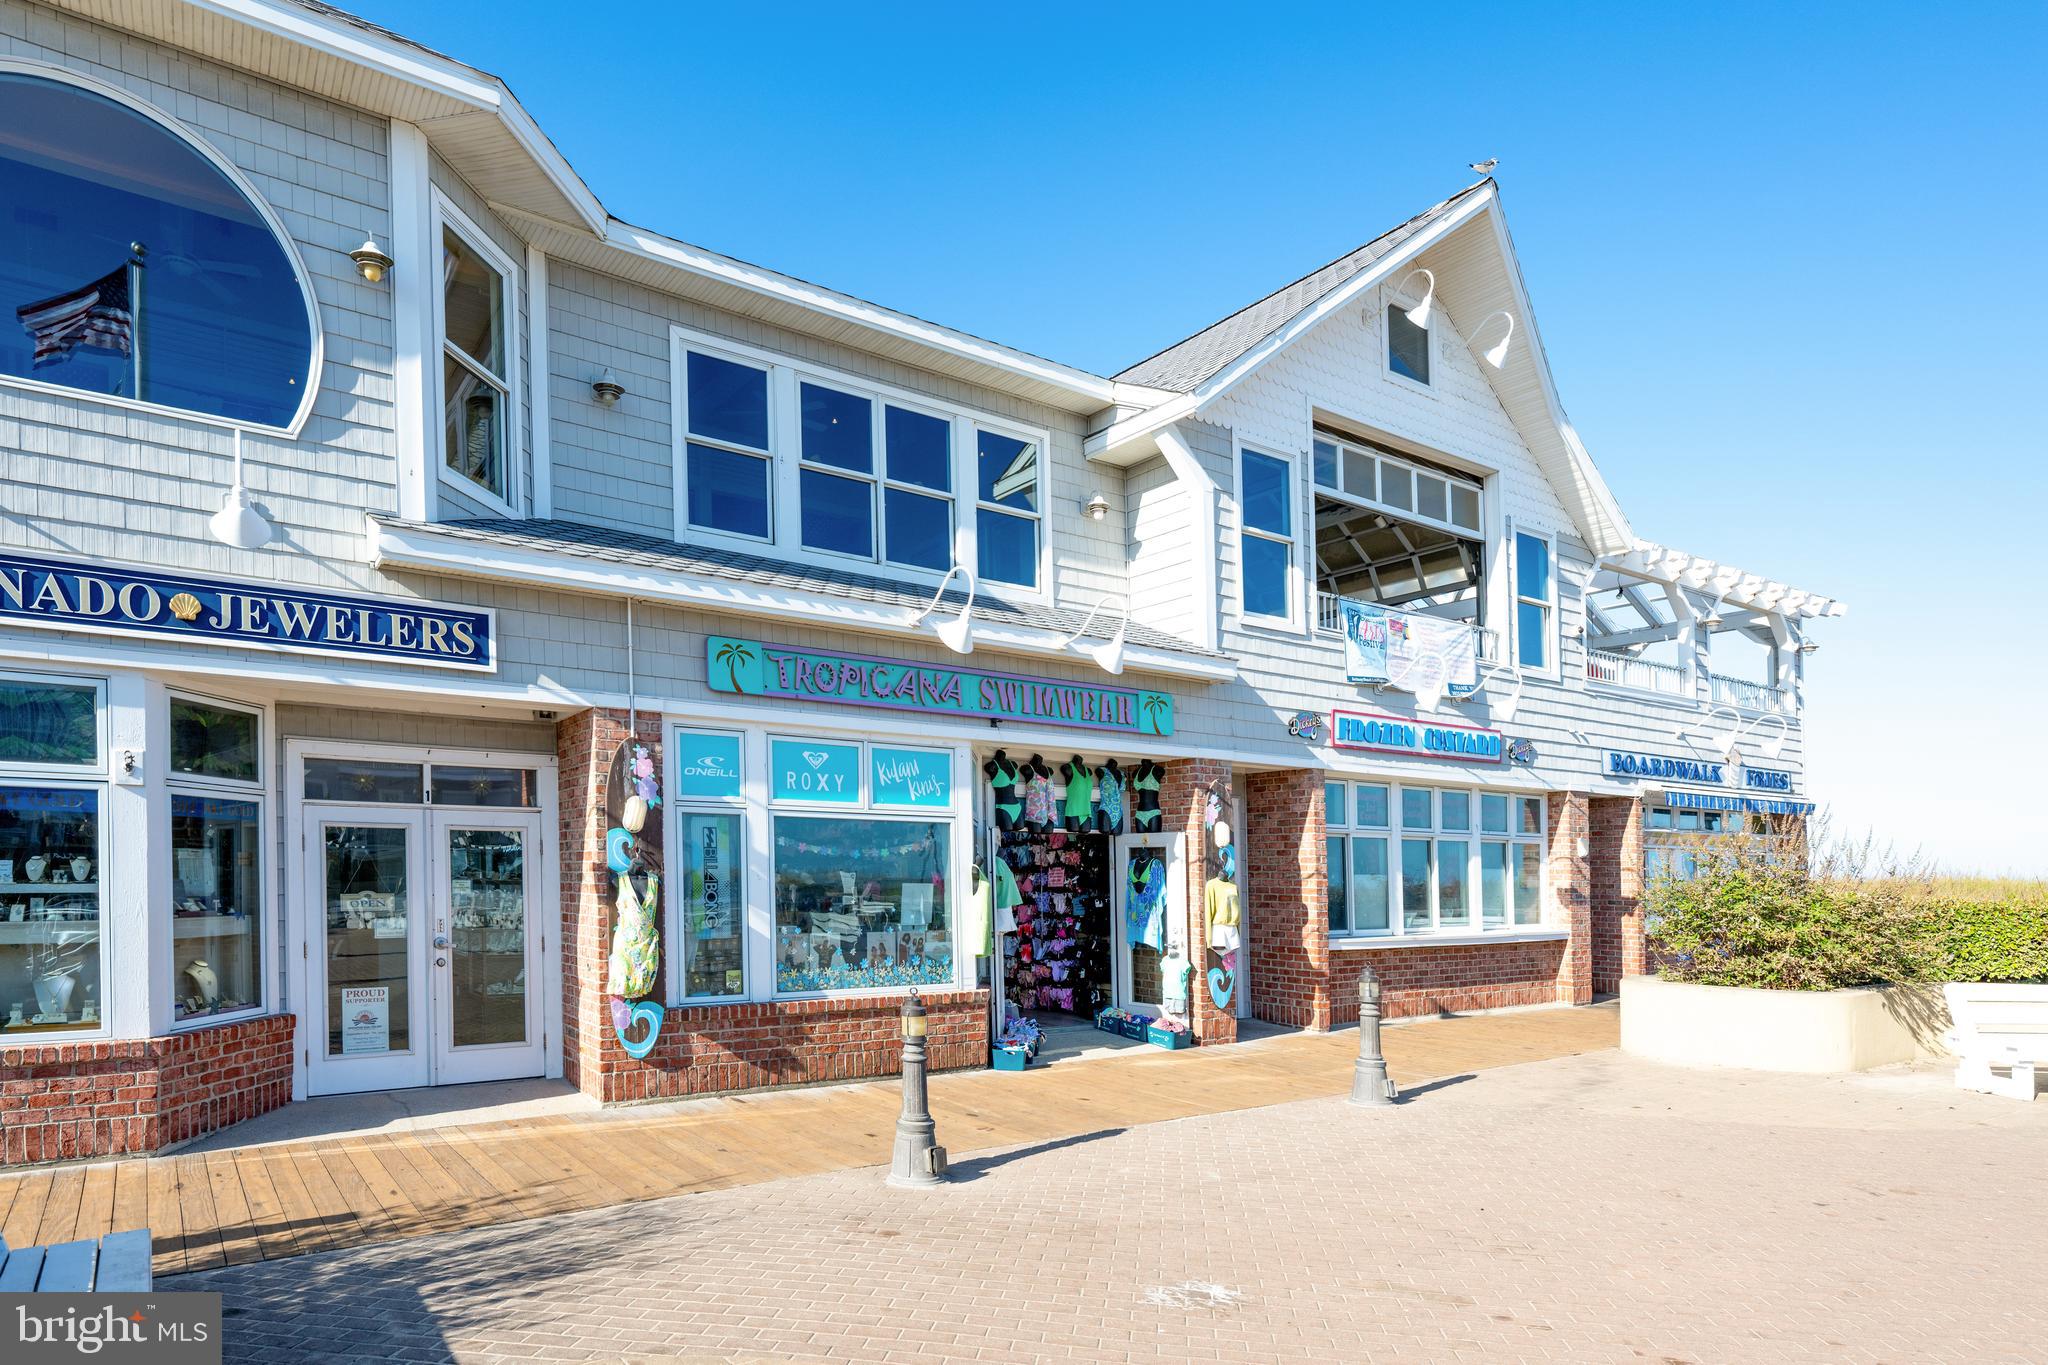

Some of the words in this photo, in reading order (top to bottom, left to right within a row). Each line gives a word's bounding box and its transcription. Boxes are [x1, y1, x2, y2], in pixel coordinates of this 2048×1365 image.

[0, 567, 161, 622] NADO
[209, 591, 476, 656] JEWELERS
[767, 653, 963, 707] TROPICANA
[979, 677, 1134, 726] SWIMWEAR
[1338, 717, 1416, 748] FROZEN
[1422, 727, 1501, 757] CUSTARD
[684, 767, 738, 778] O'NEILL
[786, 771, 845, 792] ROXY
[1609, 752, 1723, 783] BOARDWALK
[1745, 769, 1789, 790] FRIES
[425, 790, 430, 802] 1
[703, 847, 719, 929] BILLABONG
[350, 899, 386, 907] OPEN
[345, 988, 385, 998] PROUD
